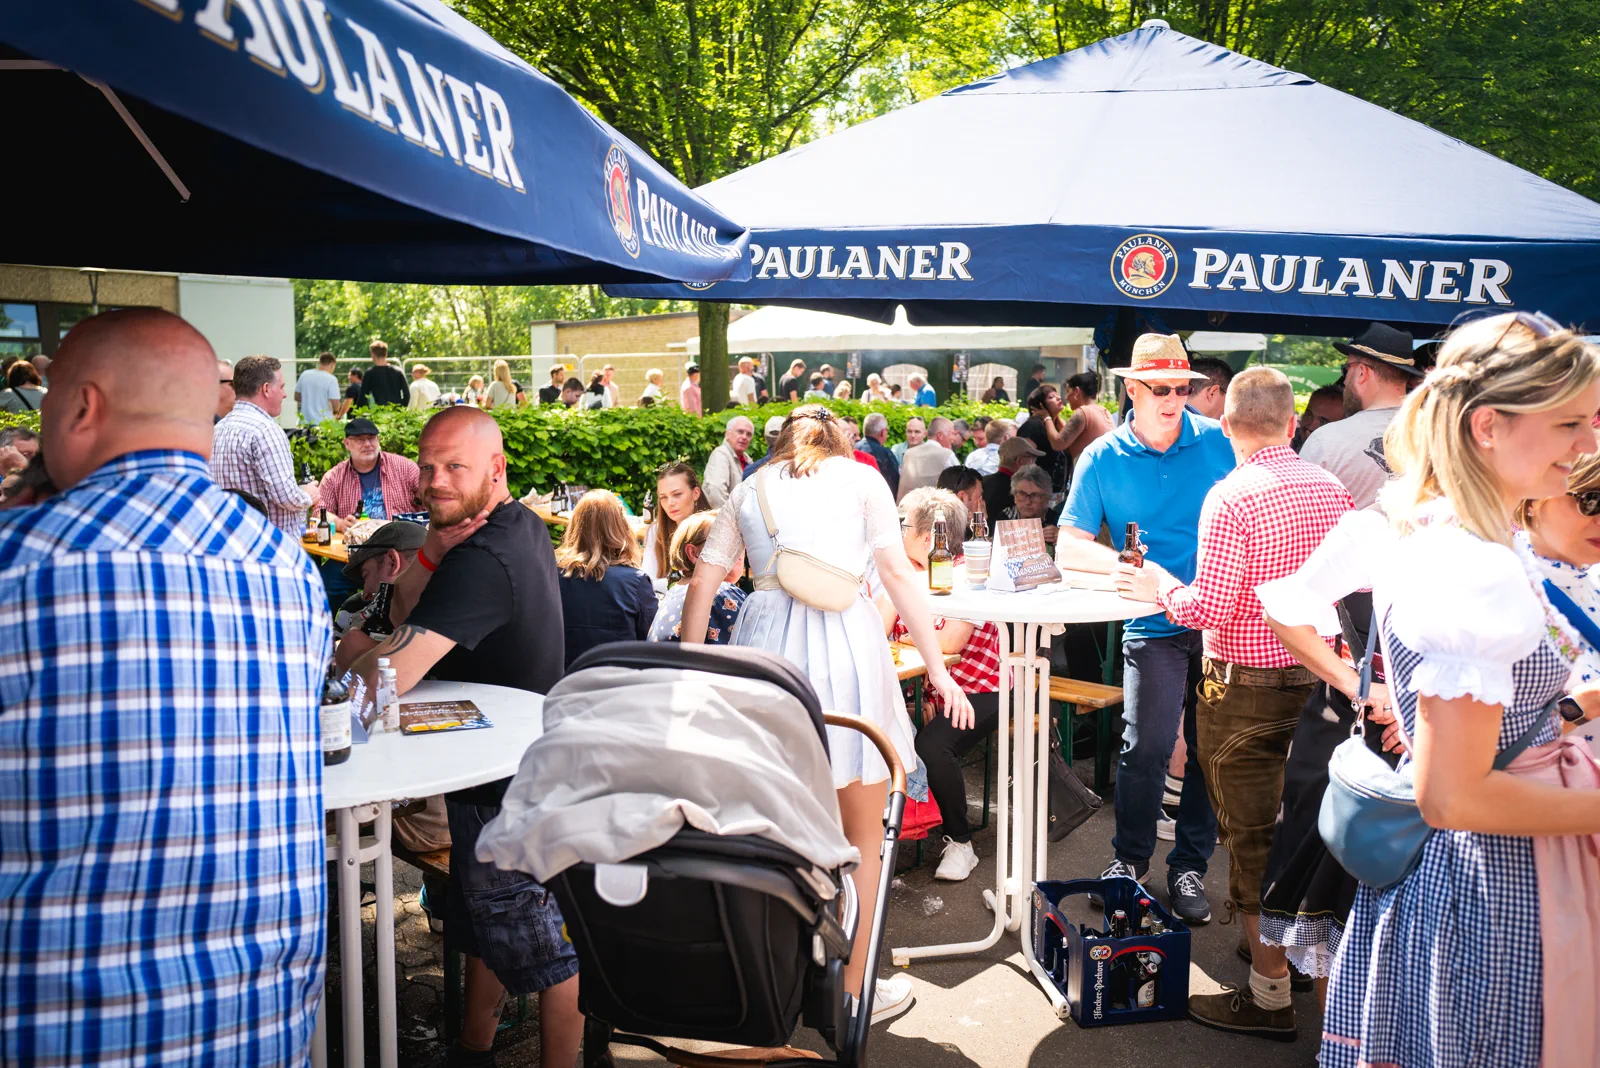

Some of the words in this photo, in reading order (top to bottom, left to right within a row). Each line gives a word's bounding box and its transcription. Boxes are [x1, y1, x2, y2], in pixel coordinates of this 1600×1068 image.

[127, 0, 527, 193] ULANER
[1117, 237, 1173, 260] PAULANER
[1188, 247, 1513, 305] PAULANER
